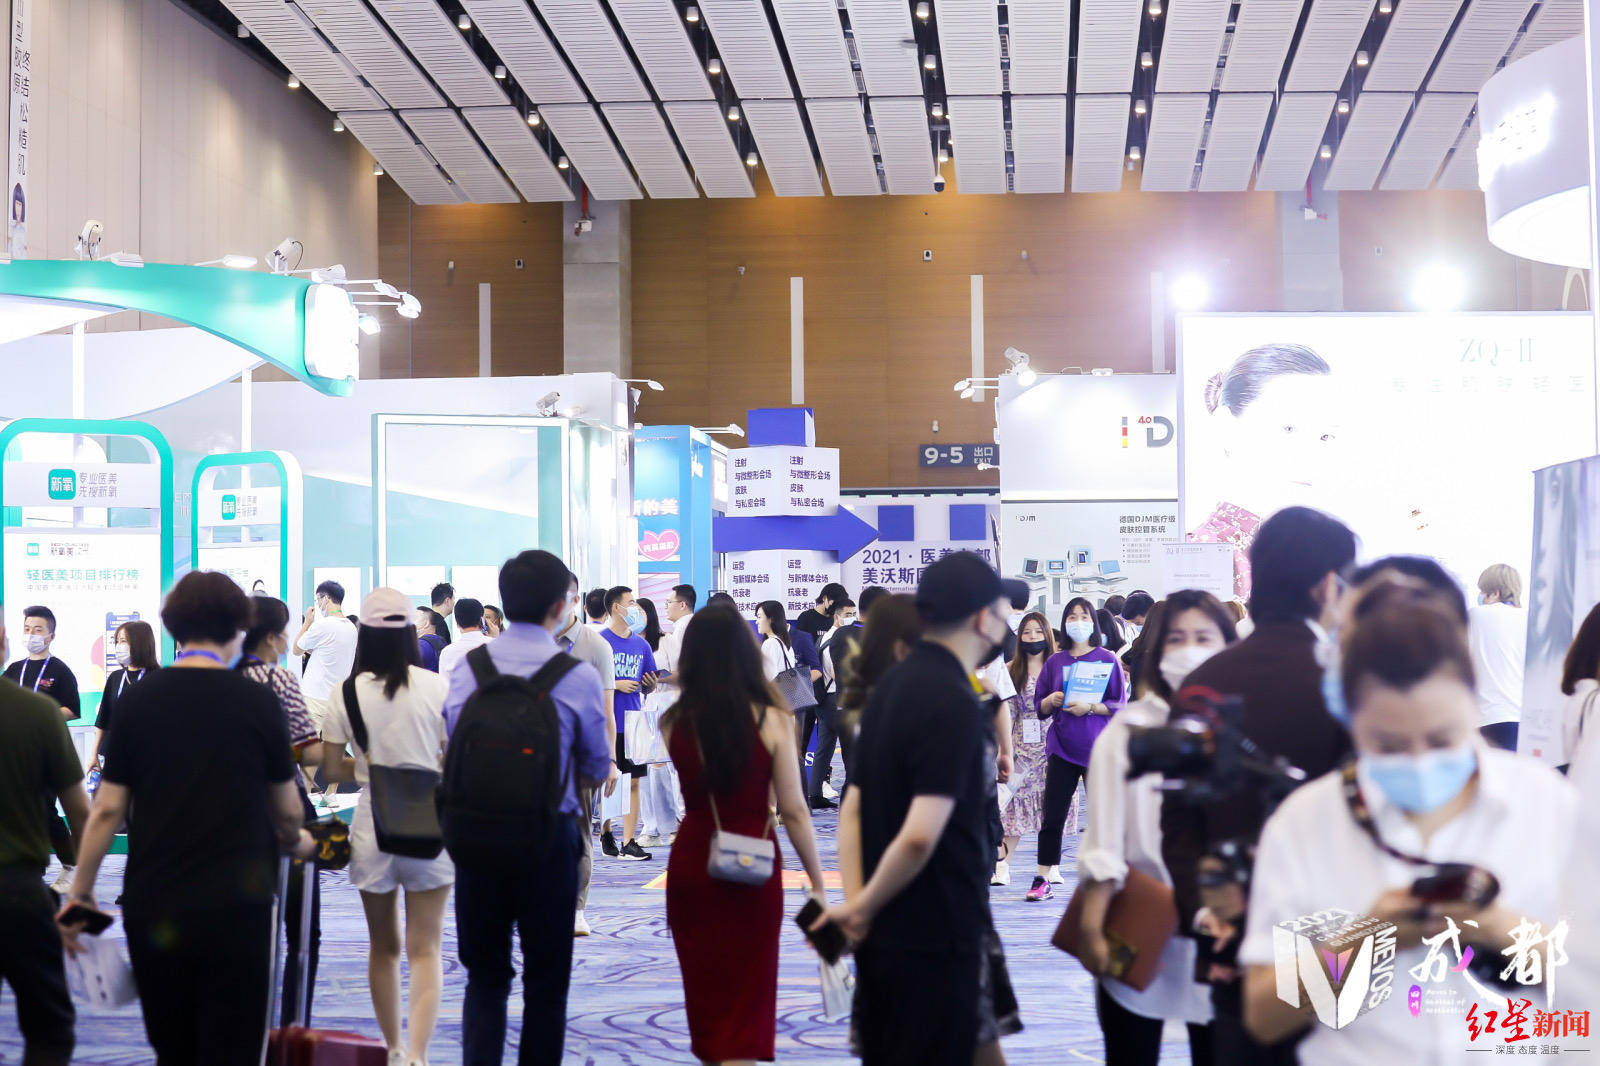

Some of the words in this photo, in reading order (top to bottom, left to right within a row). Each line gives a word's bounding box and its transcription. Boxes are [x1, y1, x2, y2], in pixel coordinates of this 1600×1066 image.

[790, 456, 804, 465] 注射
[924, 446, 964, 465] 9-5
[974, 446, 993, 457] 出口
[735, 458, 747, 467] 注射
[79, 472, 118, 485] 专业医美
[735, 470, 772, 481] 与微整形会场
[790, 469, 831, 480] 与微整形会场
[51, 476, 74, 492] 新氧
[790, 483, 804, 493] 皮肤
[79, 485, 118, 498] 先搜新氧
[735, 485, 748, 495] 皮肤
[735, 497, 766, 508] 与私密会场
[790, 497, 825, 507] 与私密会场
[732, 561, 745, 570] 运营
[788, 559, 801, 569] 运营
[26, 568, 140, 581] 轻医美项目排行榜
[732, 574, 770, 584] 与新媒体会场
[787, 573, 829, 583] 与新媒体会场
[732, 588, 751, 598] 抗衰老
[787, 587, 809, 597] 抗衰老
[787, 601, 818, 611] 新技术应
